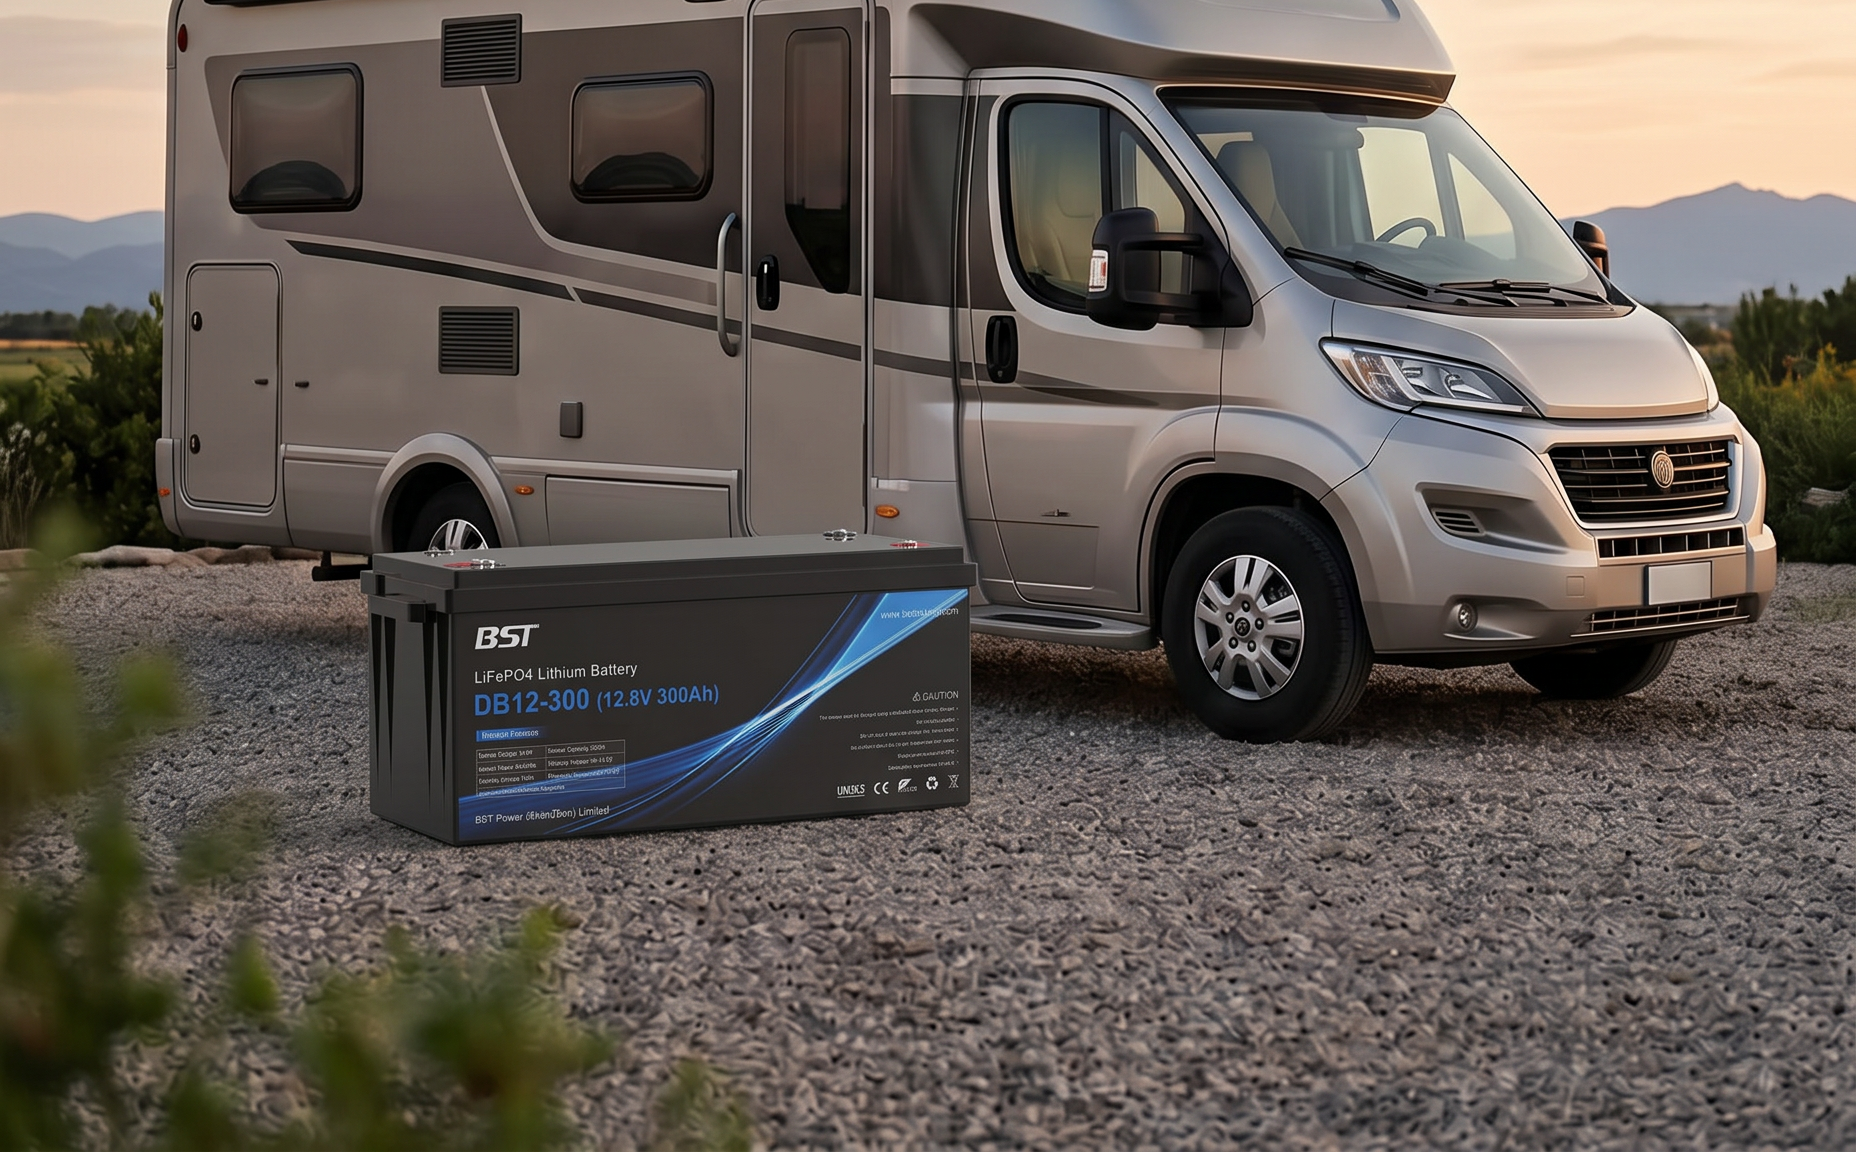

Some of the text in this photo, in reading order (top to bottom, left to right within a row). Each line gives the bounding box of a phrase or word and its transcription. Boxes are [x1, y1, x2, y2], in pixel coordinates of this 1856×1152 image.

[475, 624, 539, 649] BST
[475, 664, 638, 684] LiFePO4 Lithium Battery
[475, 684, 719, 716] DB12-300 (12.8V 300Ah)
[475, 814, 494, 824] BST
[496, 812, 523, 823] Power
[579, 805, 610, 817] Limited
